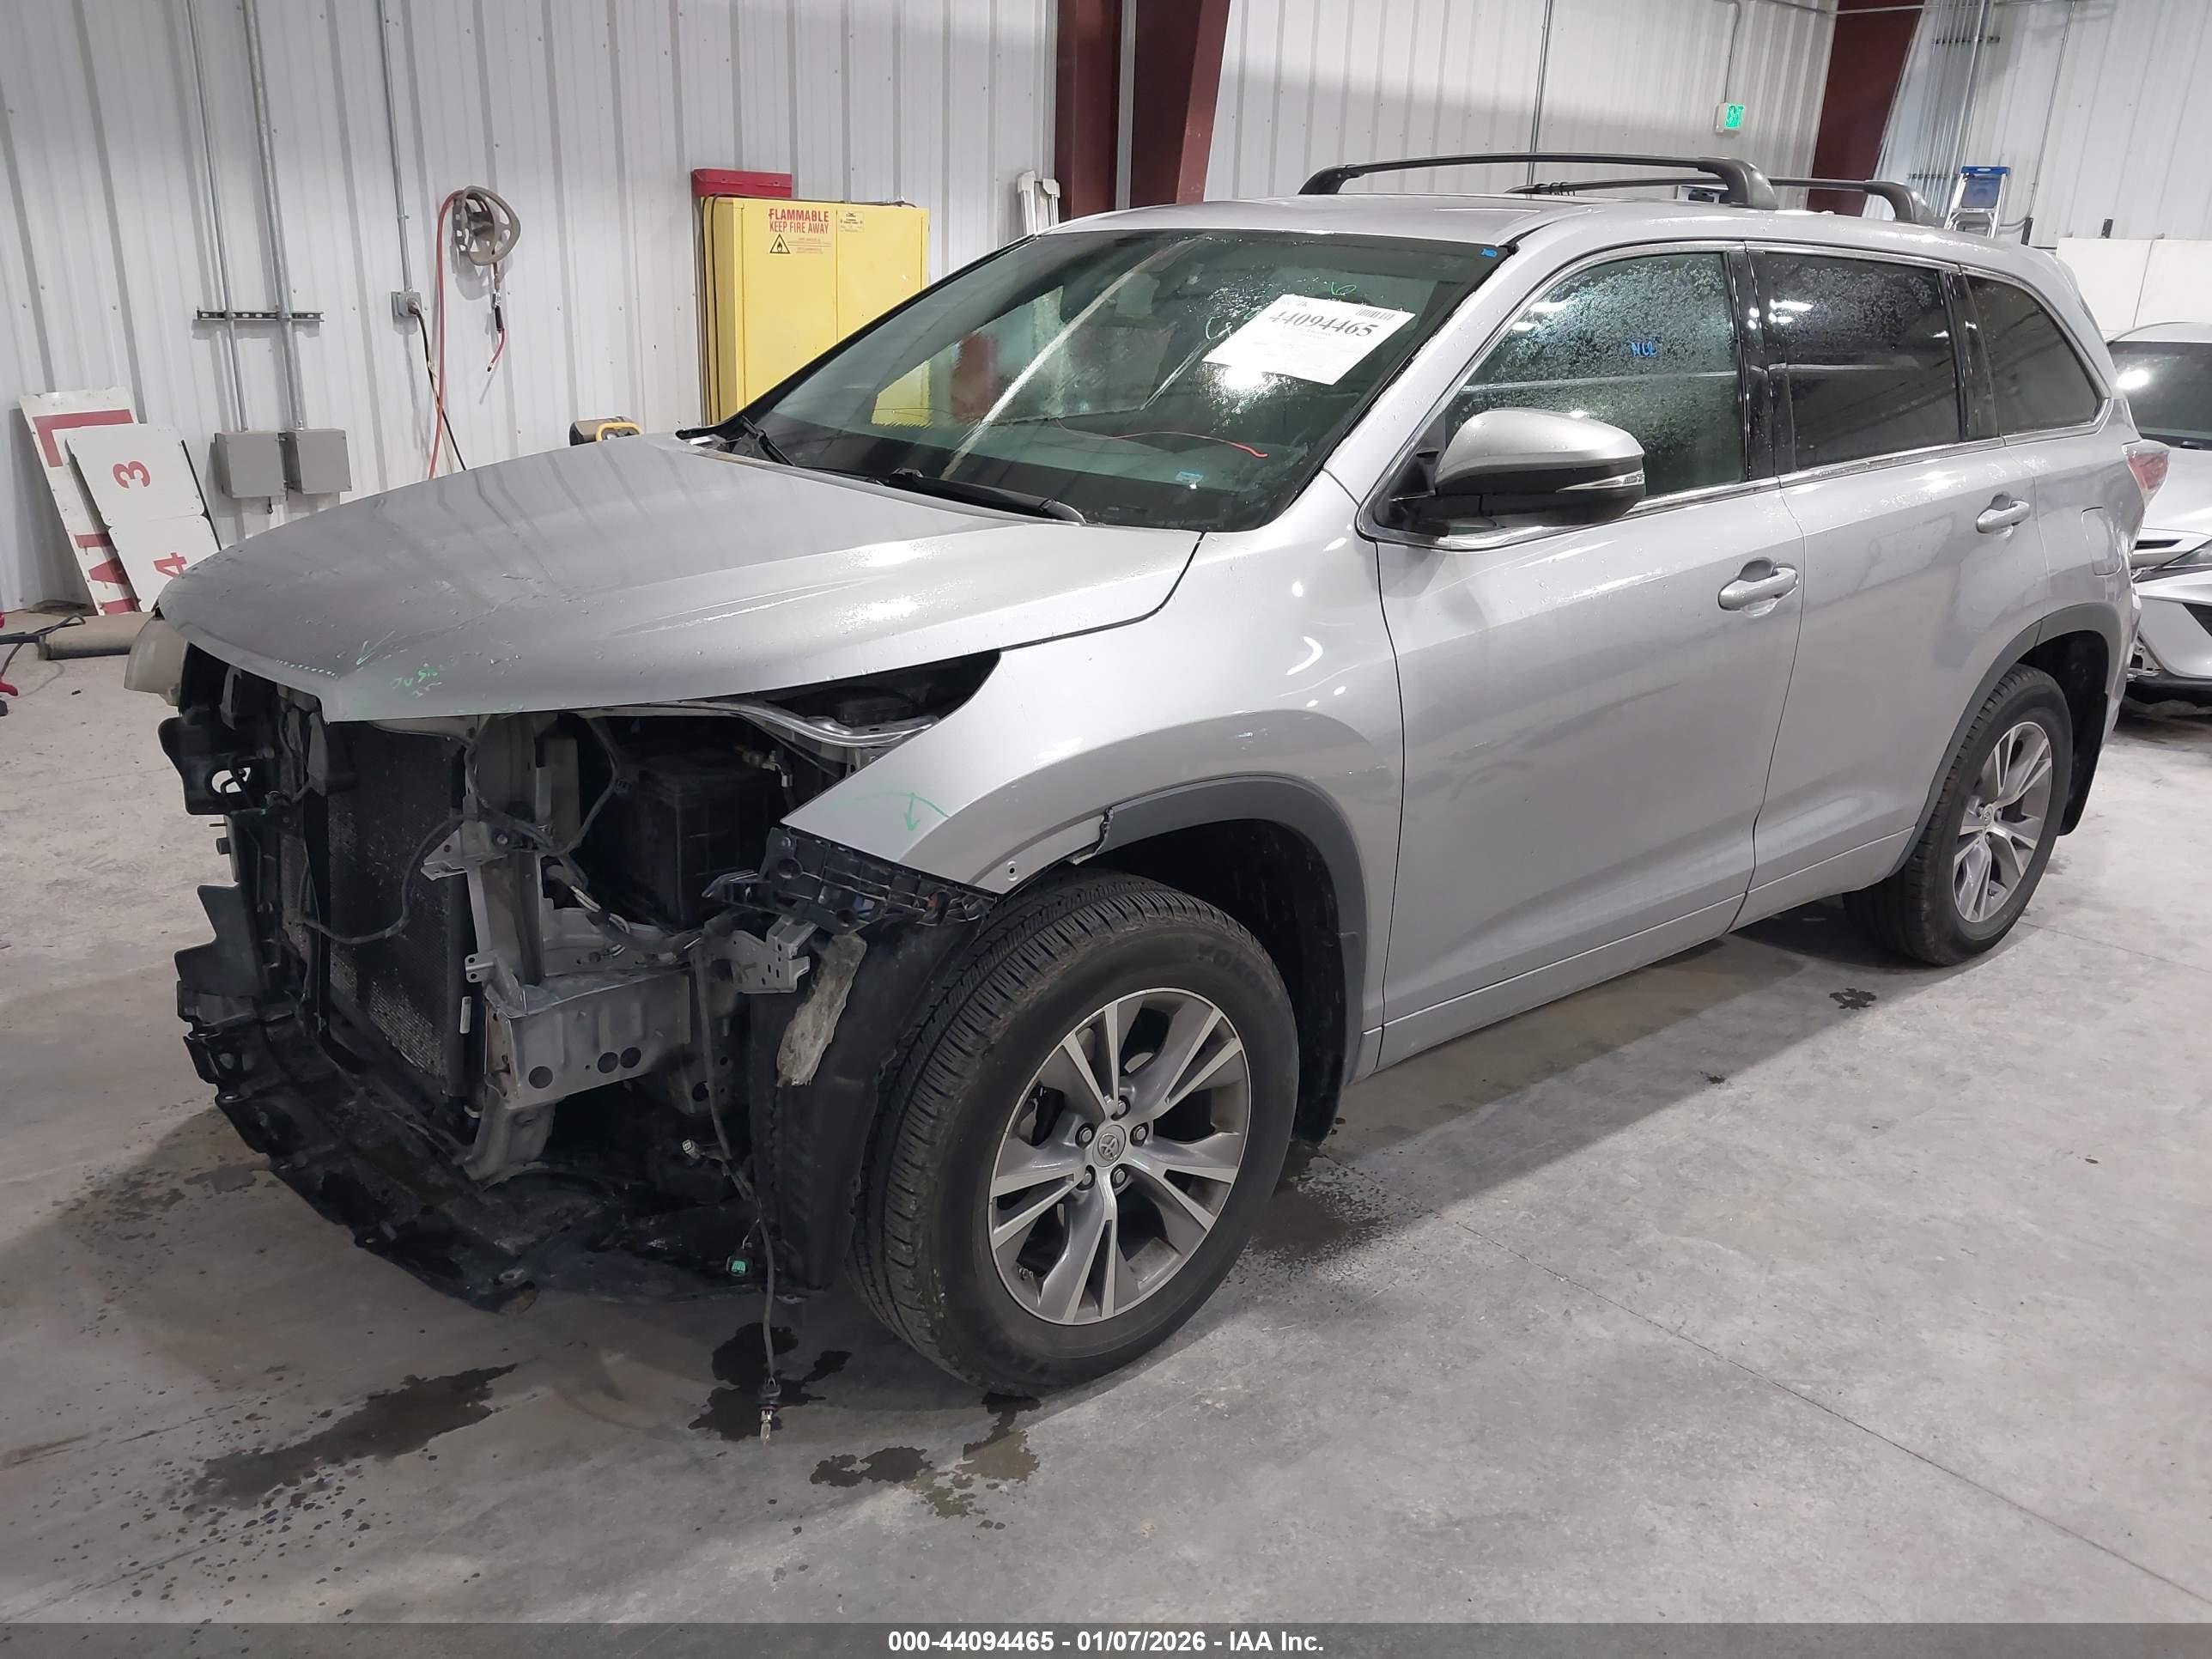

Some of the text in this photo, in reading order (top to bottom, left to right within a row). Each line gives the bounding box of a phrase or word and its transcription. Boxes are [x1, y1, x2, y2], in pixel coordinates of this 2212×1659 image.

[769, 208, 830, 222] FLAMMABLE
[769, 221, 830, 234] KEEP FIRE AWAY
[1269, 310, 1379, 337] 44094465
[112, 461, 151, 489] 3
[153, 552, 187, 578] 4
